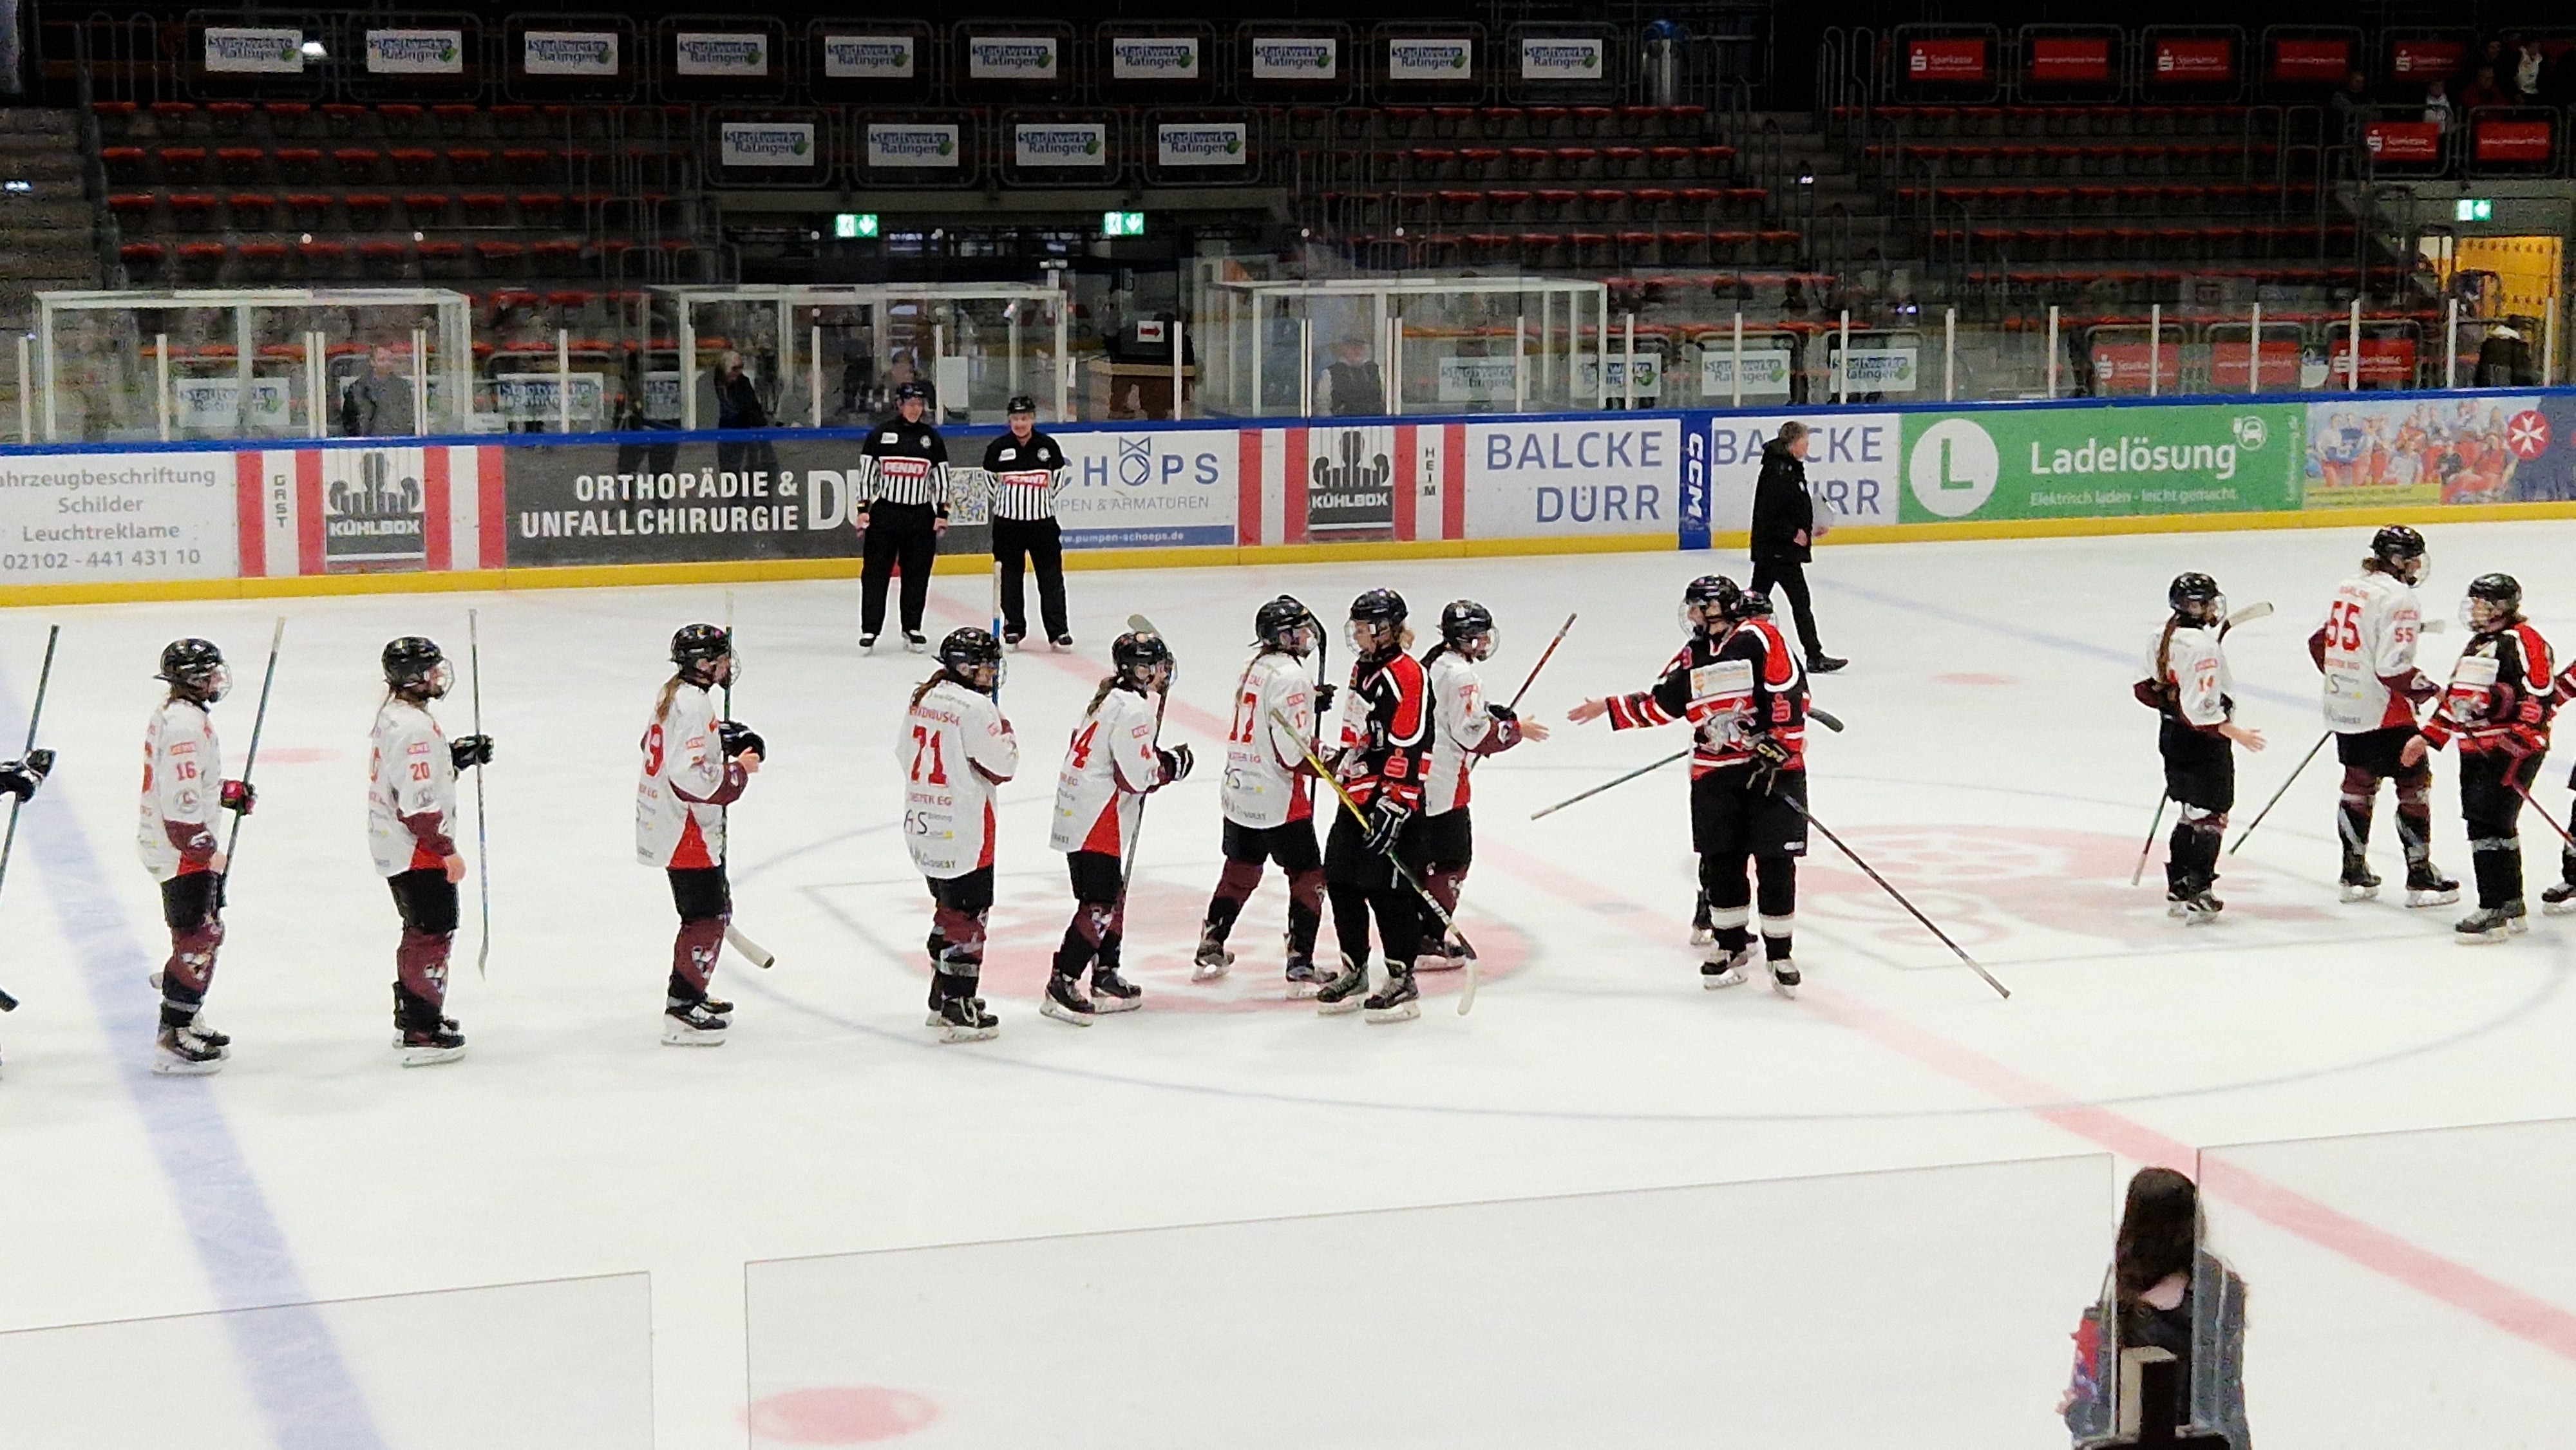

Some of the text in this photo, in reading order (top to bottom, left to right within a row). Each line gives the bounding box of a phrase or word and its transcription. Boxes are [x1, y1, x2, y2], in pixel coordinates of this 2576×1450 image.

[973, 46, 1048, 55] Stadtwerke
[1115, 46, 1189, 56] Stadtwerke
[1255, 46, 1327, 56] Stadtwerke
[1392, 47, 1462, 57] Stadtwerke
[1524, 47, 1594, 57] Stadtwerke
[691, 52, 748, 65] Ratingen
[838, 54, 895, 68] Ratingen
[983, 55, 1038, 68] Ratingen
[1126, 55, 1180, 68] Ratingen
[1265, 55, 1318, 68] Ratingen
[1401, 56, 1453, 69] Ratingen
[1534, 56, 1585, 69] Ratingen
[724, 132, 804, 142] Stadtwerke
[871, 133, 949, 143] Stadtwerke
[1018, 132, 1096, 142] Stadtwerke
[1161, 132, 1236, 142] Stadtwerke
[735, 142, 794, 155] Ratingen
[881, 142, 938, 156] Ratingen
[1028, 142, 1086, 155] Ratingen
[1171, 142, 1227, 155] Ratingen
[1487, 430, 1663, 471] BALCKE
[1713, 426, 1883, 465] BACKE
[1940, 438, 1974, 490] L
[2031, 437, 2236, 480] Ladelösung
[883, 461, 925, 475] PENNY
[1687, 432, 1703, 518] CCM
[576, 468, 799, 502] ORTHOPÄDIE &
[58, 495, 144, 514] Schilder
[1097, 498, 1107, 511] &
[1112, 496, 1209, 511] ARMATUREN
[1312, 493, 1388, 509] KÜHLBOX
[1537, 484, 1660, 523] DÜRR
[2030, 491, 2092, 507] Elektrisch
[2095, 489, 2131, 504] laden
[2141, 488, 2176, 502] leicht
[521, 505, 799, 538] UNFALLCHIRURGIE
[23, 522, 180, 541] Leuchtreklame
[3, 552, 69, 570] 02102
[86, 551, 123, 567] 441
[131, 550, 168, 566] 431
[176, 549, 200, 565] 10
[2325, 601, 2361, 650] 55
[2395, 626, 2414, 643] 55
[911, 724, 949, 787] 71
[1141, 744, 1151, 760] 4
[176, 760, 196, 782] 16
[410, 762, 430, 780] 20
